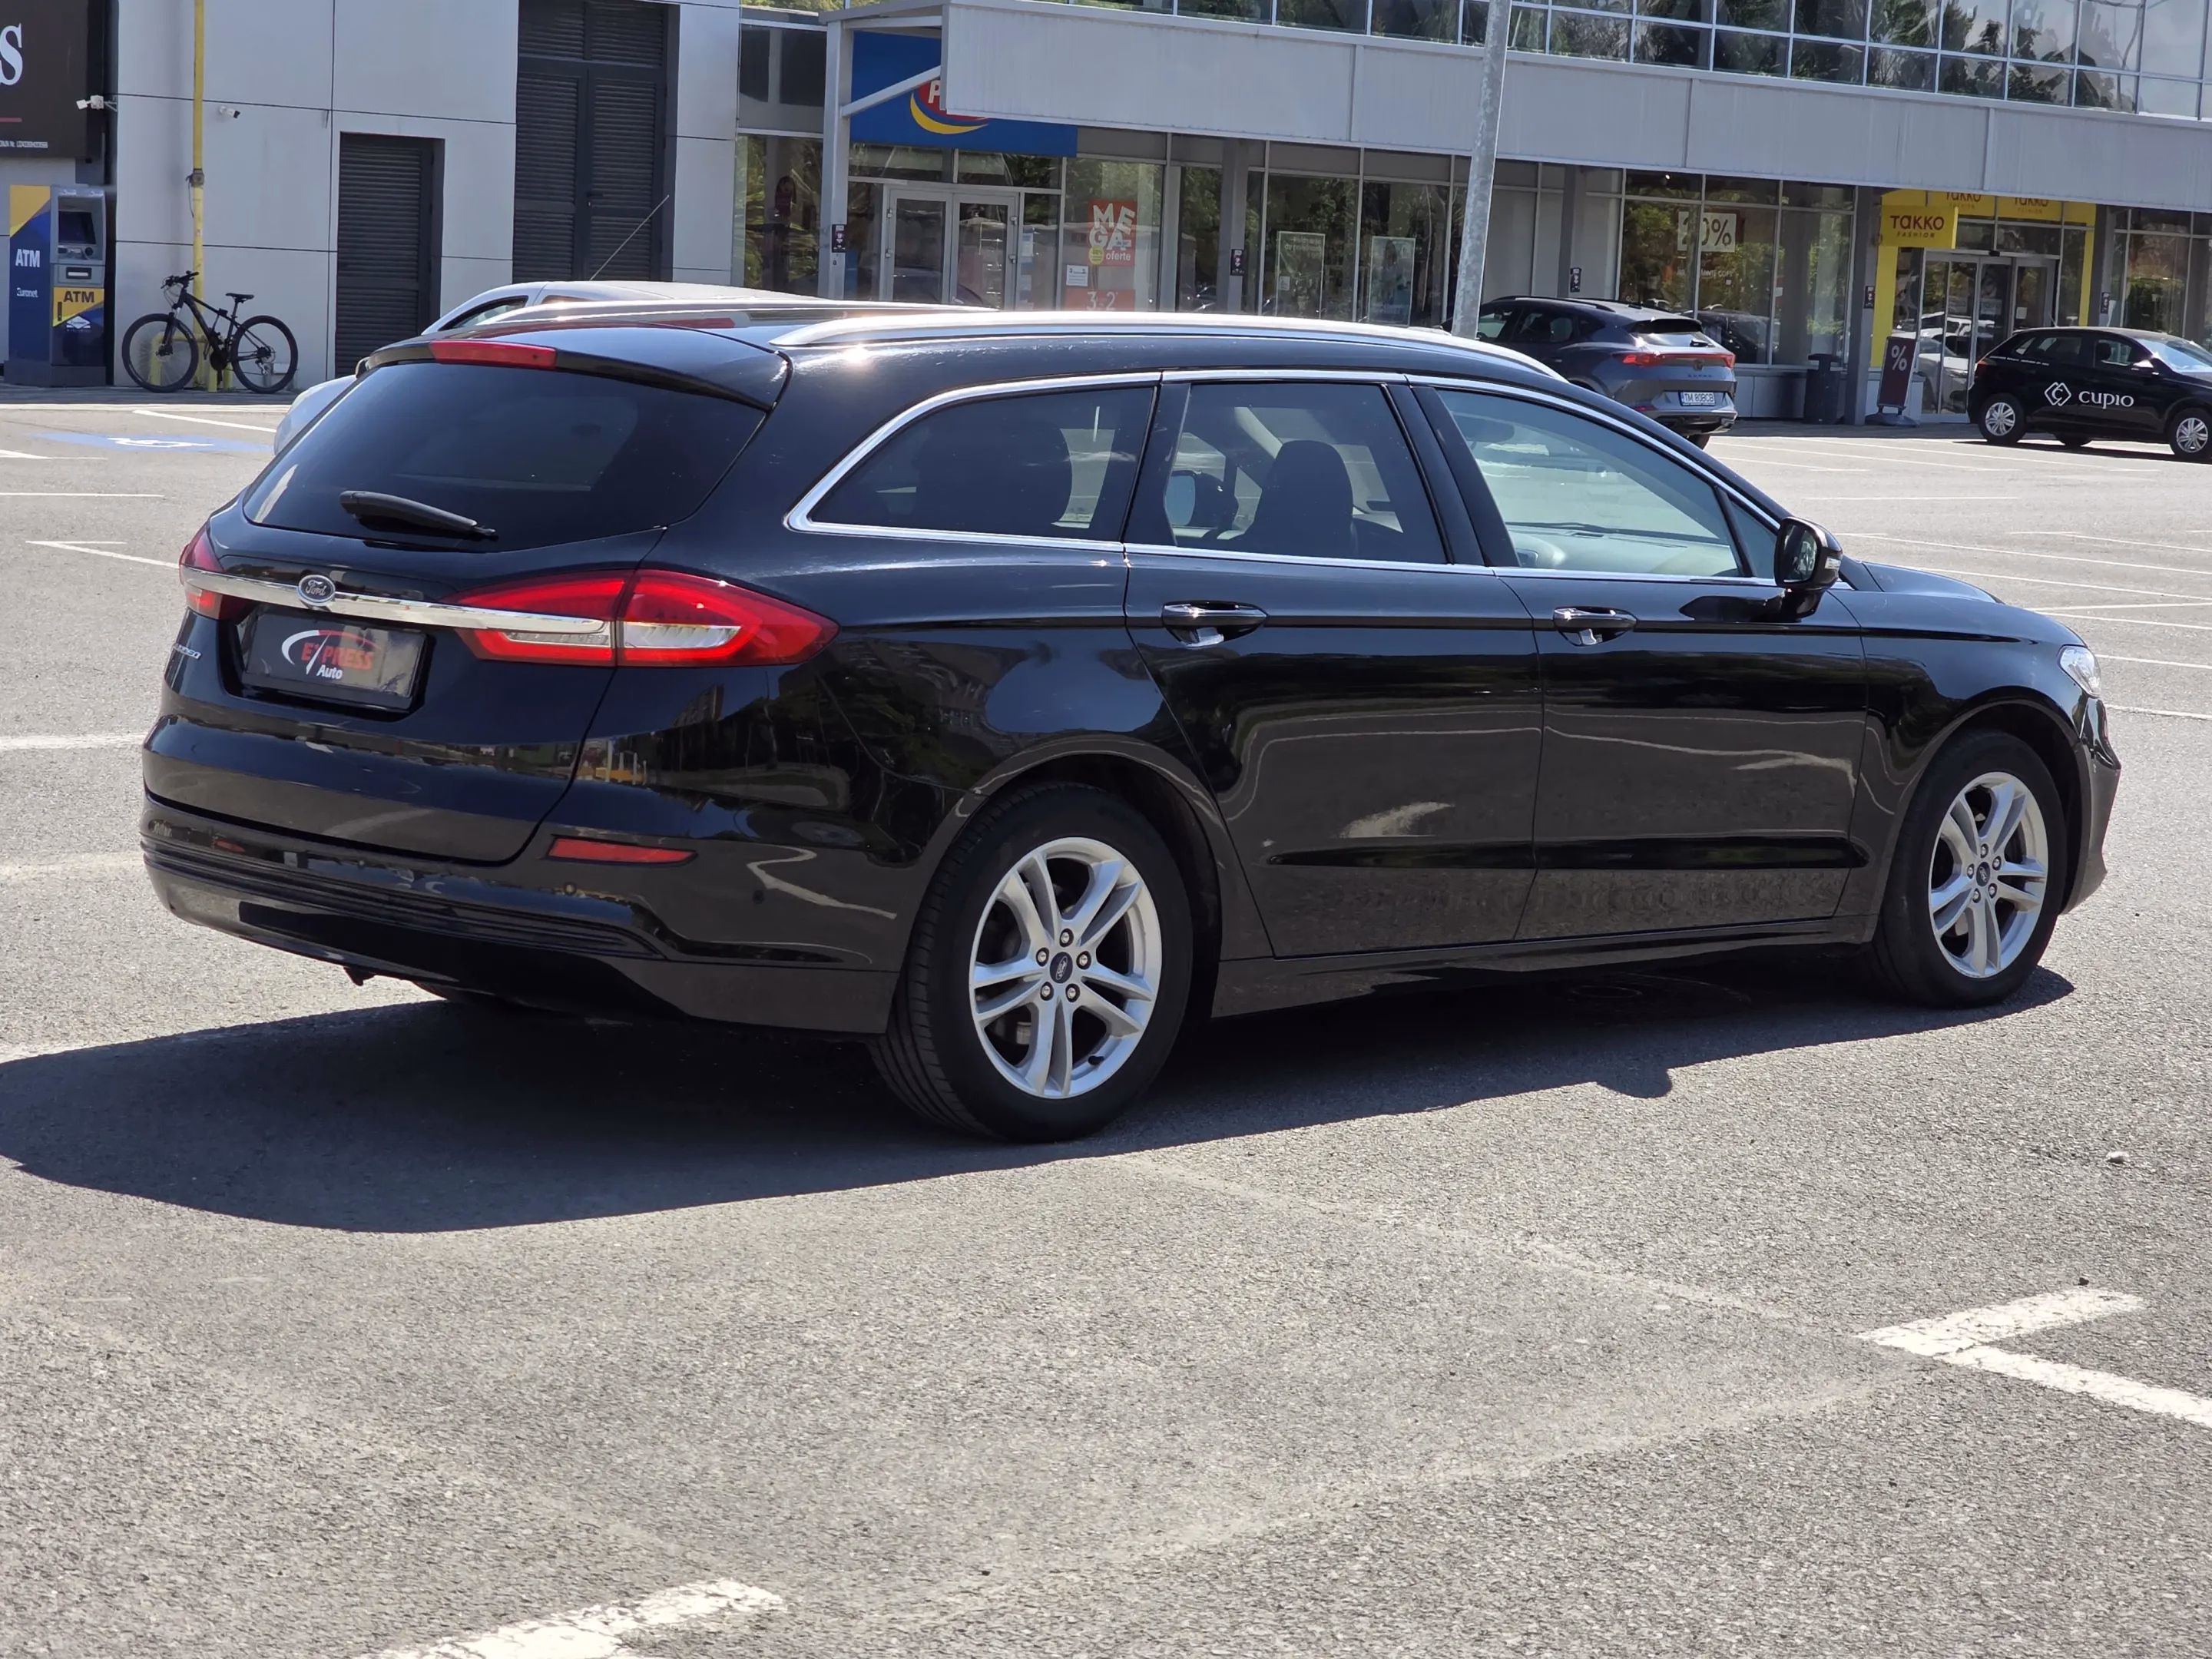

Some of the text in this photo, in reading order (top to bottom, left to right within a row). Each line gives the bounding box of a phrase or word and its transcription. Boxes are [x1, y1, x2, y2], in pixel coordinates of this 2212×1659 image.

[15, 249, 40, 267] ATM
[1106, 250, 1131, 261] oferte
[64, 290, 94, 303] ATM
[305, 579, 327, 596] Ford
[316, 664, 343, 680] Auto
